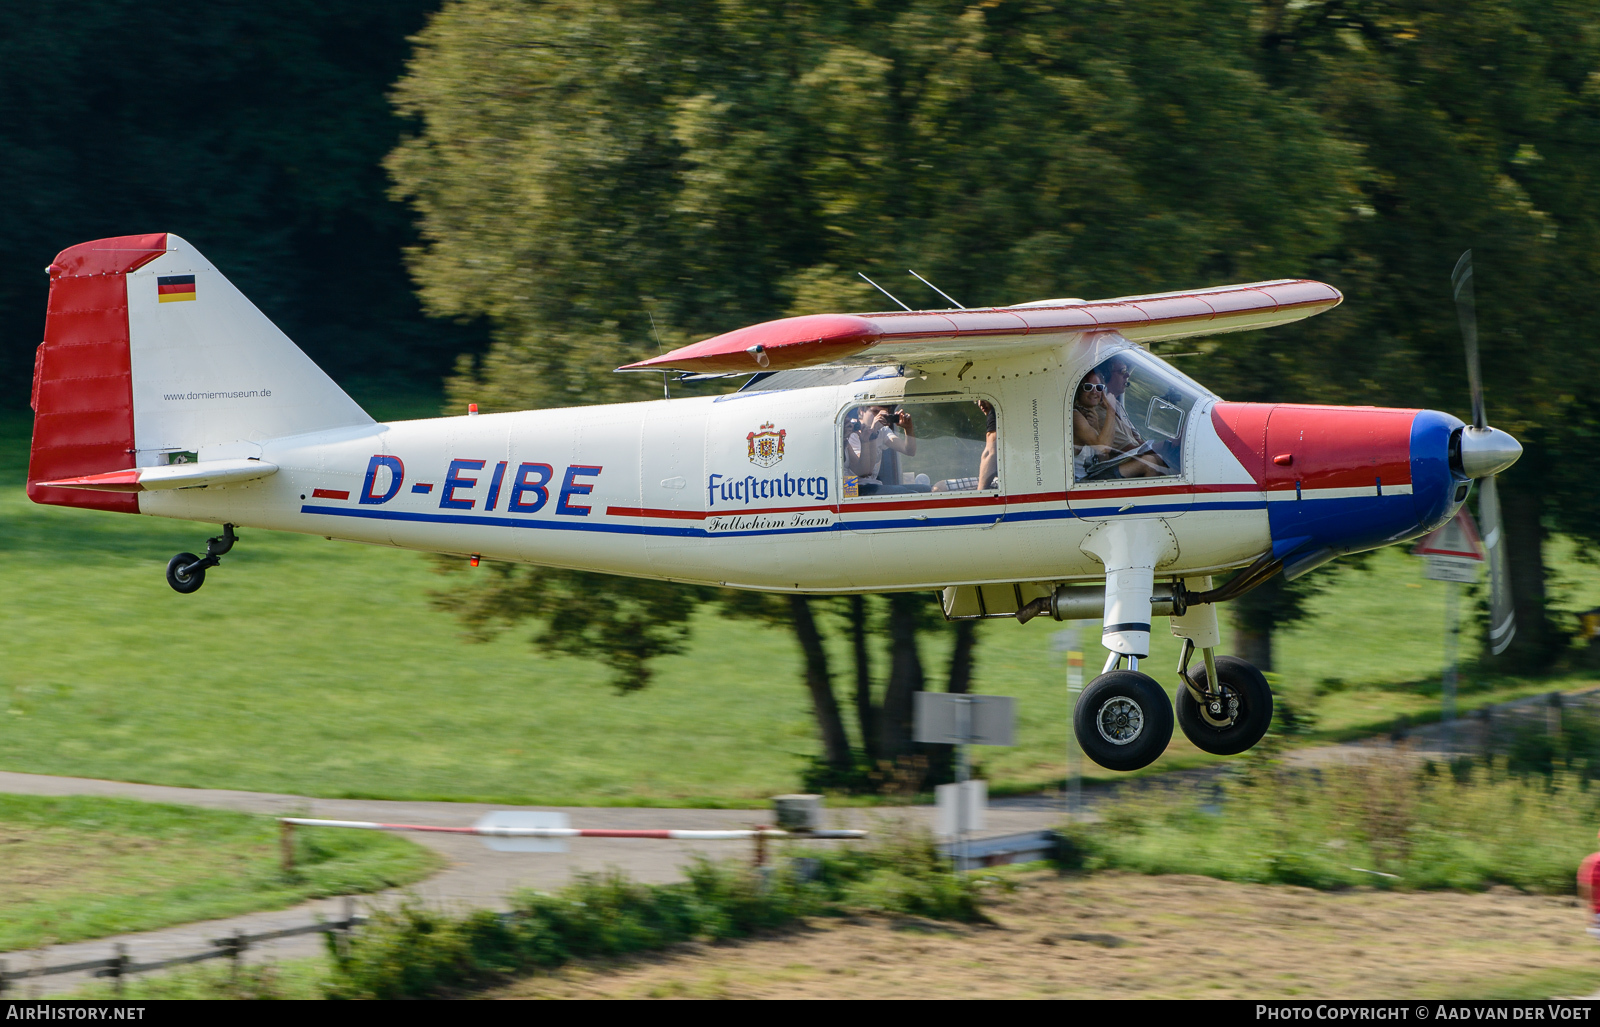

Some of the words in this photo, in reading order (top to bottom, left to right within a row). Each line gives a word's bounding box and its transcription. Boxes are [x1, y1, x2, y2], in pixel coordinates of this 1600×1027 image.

[163, 388, 272, 401] www.dorniermuseum.de
[1031, 398, 1044, 486] www.dorniermuseum.de
[359, 454, 603, 516] D-EIBE
[709, 516, 785, 532] Fallschirm
[790, 512, 830, 527] Team
